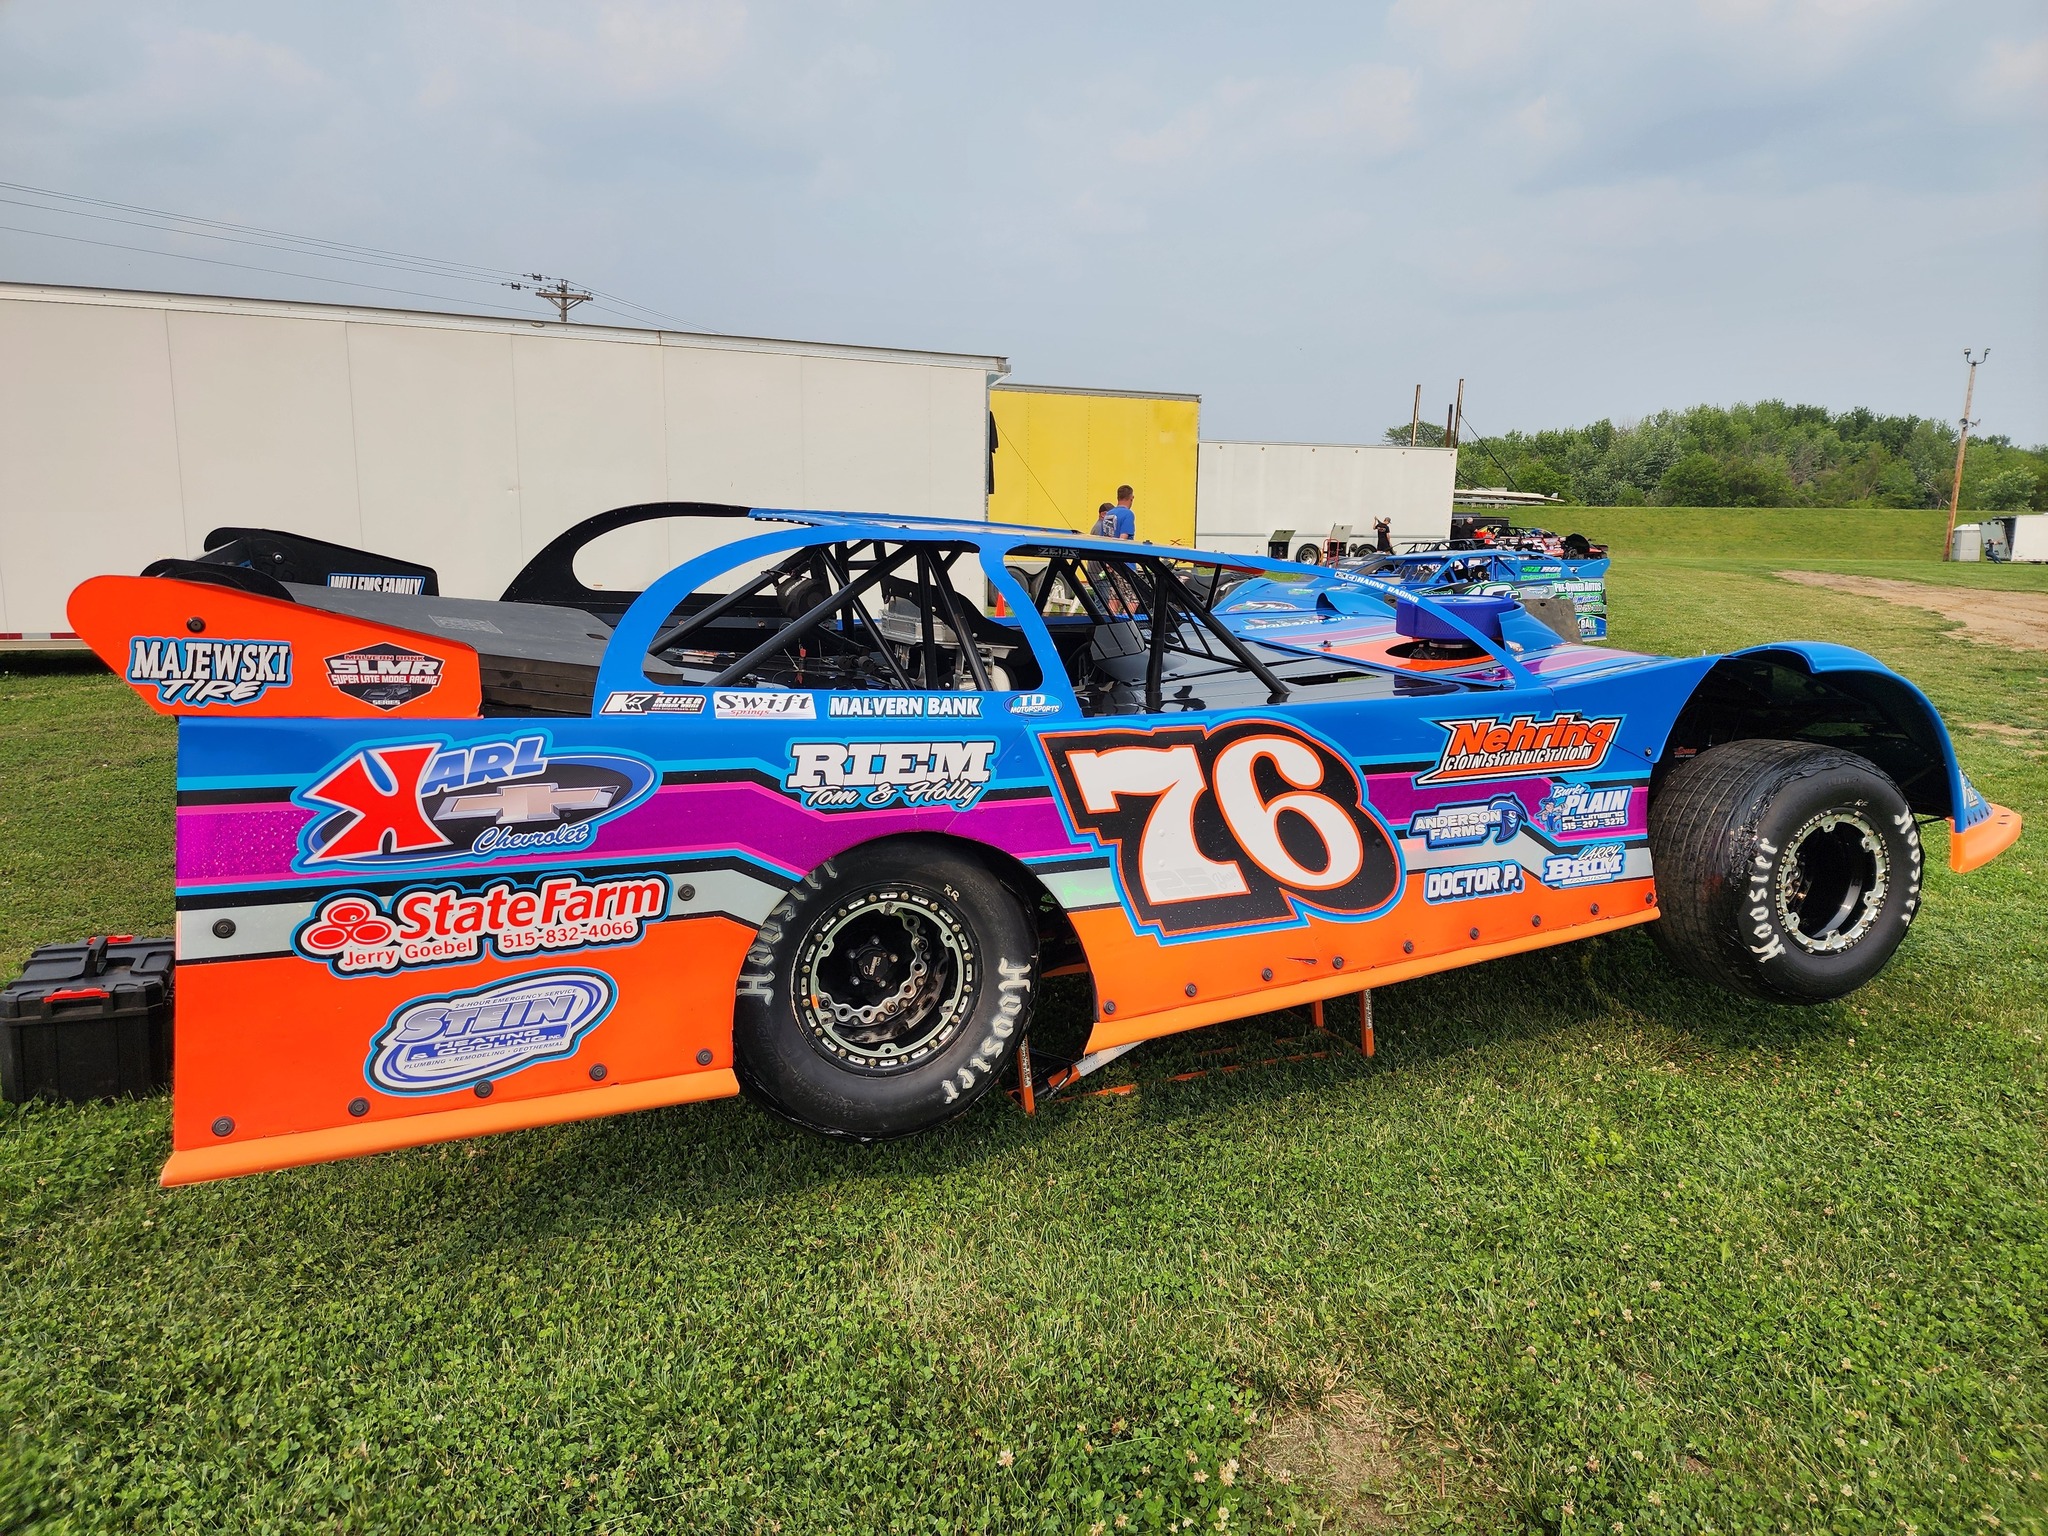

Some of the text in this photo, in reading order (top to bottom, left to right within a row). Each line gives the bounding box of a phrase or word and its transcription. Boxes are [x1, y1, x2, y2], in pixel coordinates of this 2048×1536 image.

[131, 640, 291, 682] MAJEWSKI
[330, 660, 439, 675] SLMR
[160, 678, 264, 702] TIRE
[331, 674, 438, 685] SUPER LATE MODEL RACING
[730, 708, 771, 716] springs
[829, 697, 981, 716] MALVERN BANK
[1010, 704, 1059, 713] MOTORSPORTS
[1018, 694, 1046, 706] TD
[1451, 717, 1615, 755] Nehring
[788, 742, 995, 787] RIEM
[1445, 745, 1593, 771] CONSTRUCTION
[802, 779, 983, 807] Tom & Holly
[1552, 784, 1587, 799] Burke
[1562, 790, 1629, 816] PLAIN
[1065, 733, 1363, 905] 76
[1414, 810, 1501, 831] ANDERSON
[1562, 817, 1626, 830] 515-297-3275
[471, 824, 592, 855] Chevrolet
[1430, 824, 1486, 840] FARMS
[1578, 845, 1622, 862] LARRY
[1776, 841, 1795, 890] FORGED
[1794, 809, 1832, 838] WHEELS
[943, 883, 961, 902] RR
[1427, 864, 1521, 899] DOCTOR P.
[1750, 837, 1787, 963] Hoosier
[344, 921, 634, 967] Jerry Goebel 515-832-4066
[455, 988, 578, 1009] 24-HOUR EMERGENCY SERVICE
[395, 994, 575, 1042] STEIN
[941, 957, 1032, 1104] Hoosier
[411, 1052, 429, 1060] &
[437, 1035, 543, 1056] COOLING
[434, 1030, 541, 1051] HEATING
[404, 1042, 564, 1069] PLUMBING REMODELING GEOTHERMAL
